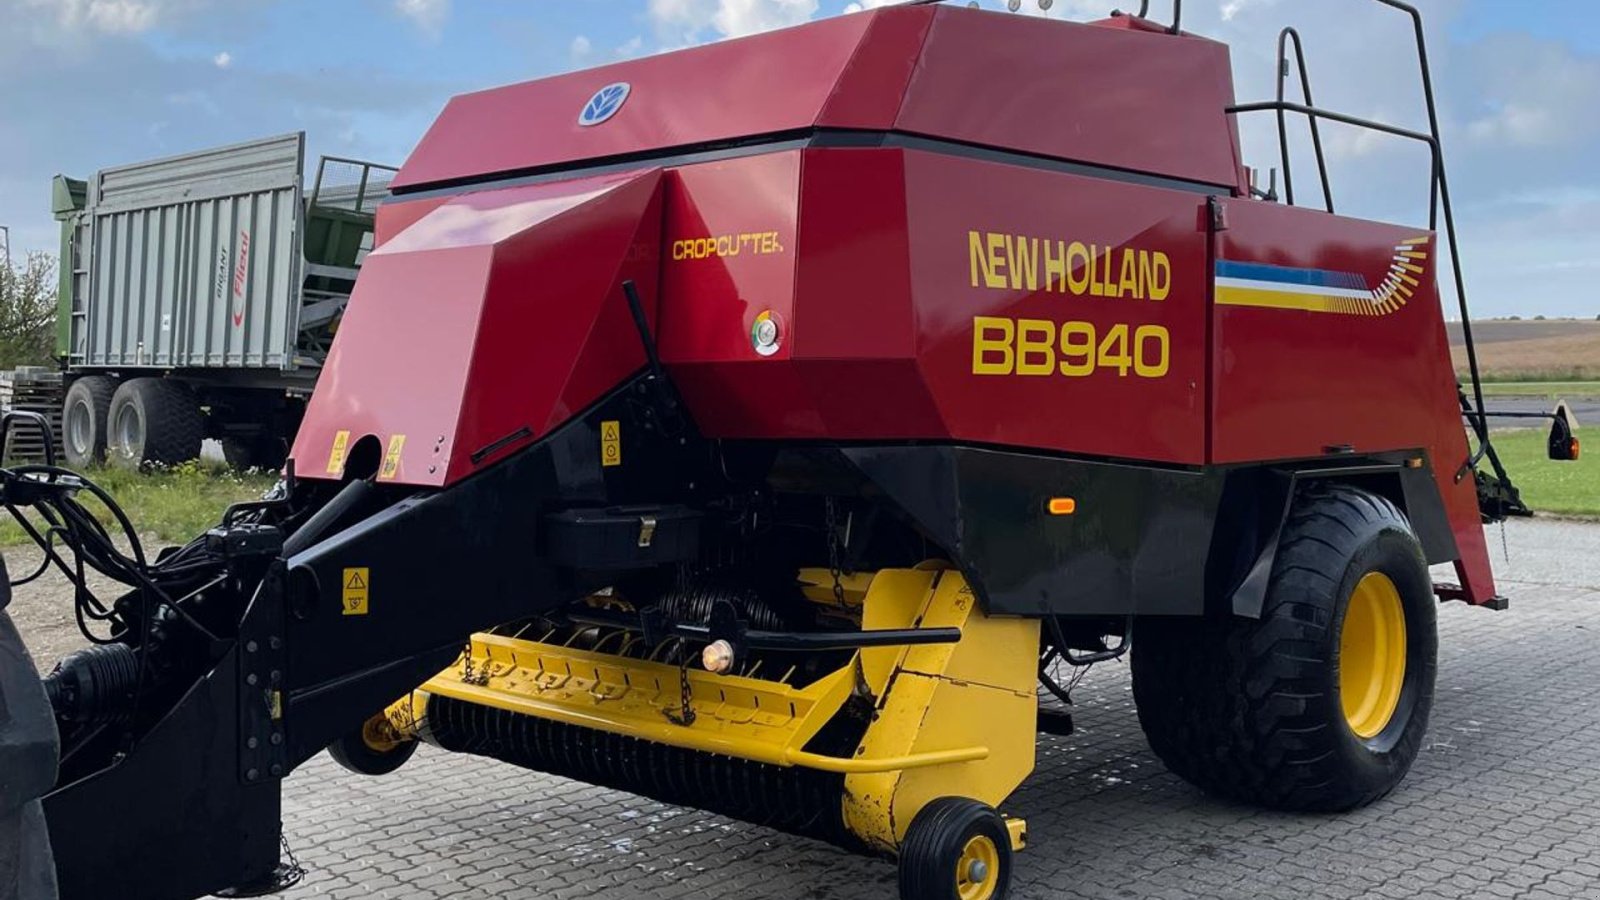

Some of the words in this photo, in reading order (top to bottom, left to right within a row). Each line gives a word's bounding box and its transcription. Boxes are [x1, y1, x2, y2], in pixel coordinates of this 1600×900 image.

[217, 245, 228, 299] GIGANT
[968, 231, 1039, 291] NEW
[1043, 239, 1171, 301] HOLLAND
[972, 316, 1170, 378] BB940
